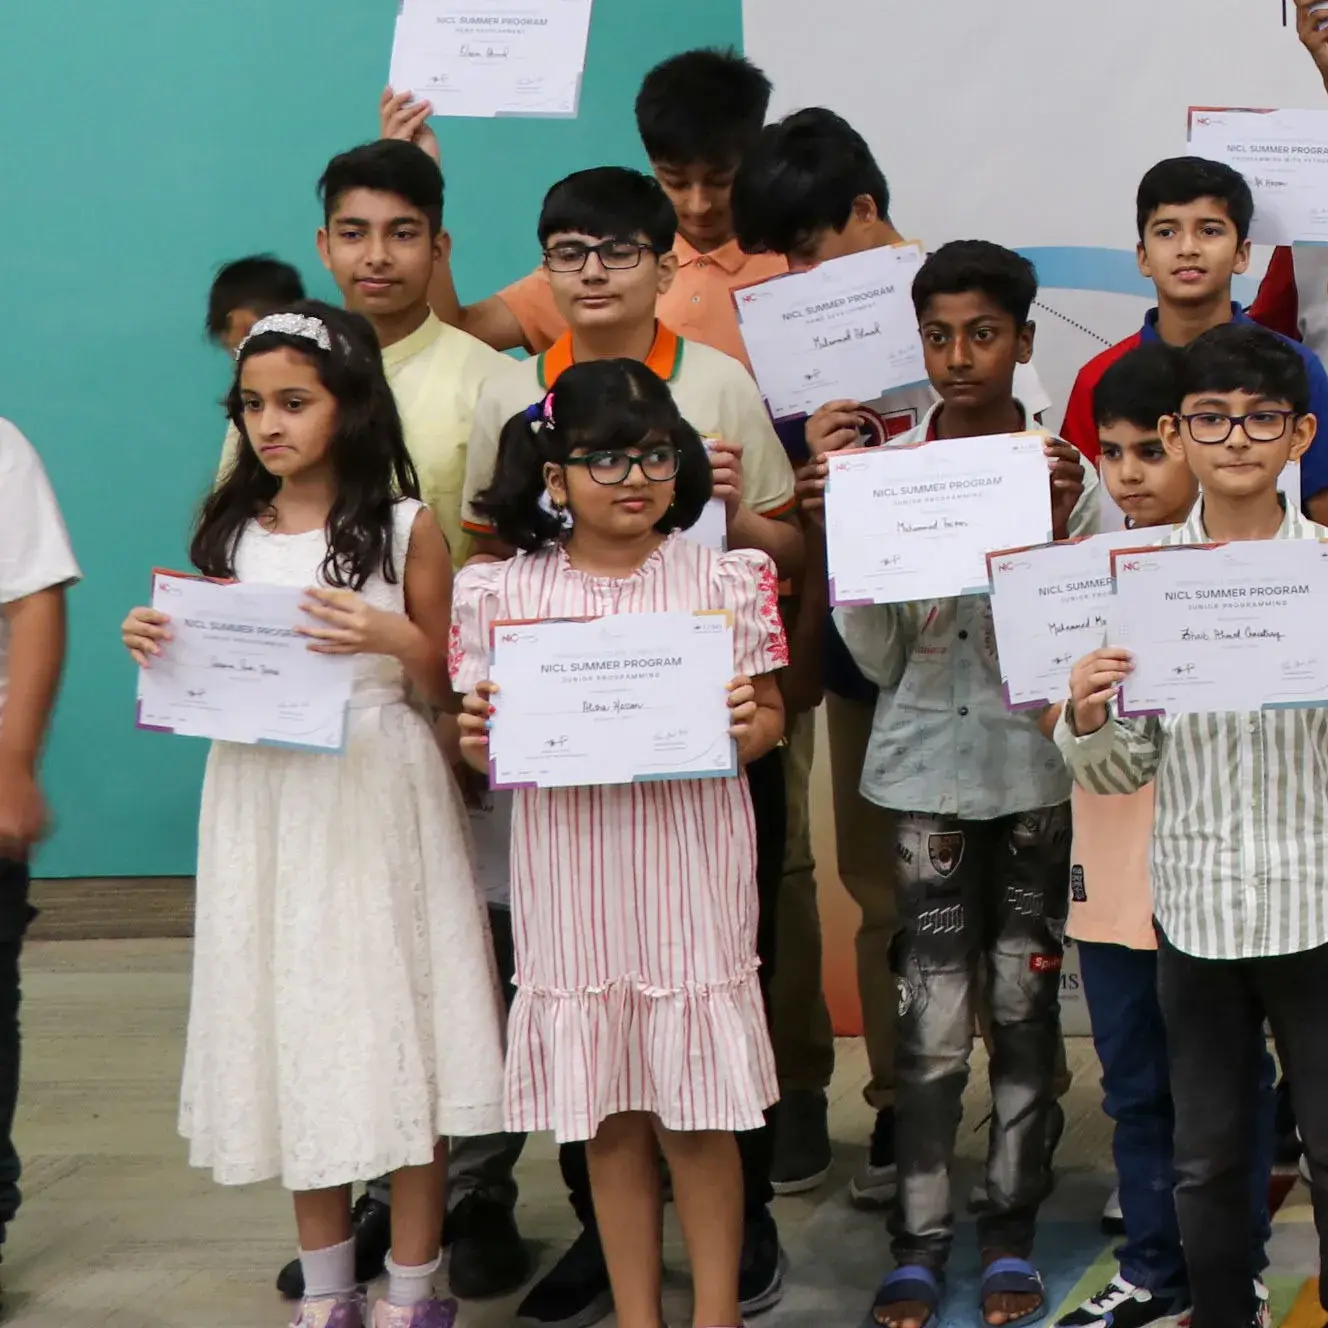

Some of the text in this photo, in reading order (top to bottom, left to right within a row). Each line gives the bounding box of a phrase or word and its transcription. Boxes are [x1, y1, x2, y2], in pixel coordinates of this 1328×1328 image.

[1250, 145, 1289, 153] SUMMER
[782, 310, 803, 321] NICL
[805, 299, 846, 315] SUMMER
[848, 286, 894, 303] PROGRAM
[873, 477, 1002, 498] NICL SUMMER PROGRAM
[1123, 561, 1139, 571] NIC
[1039, 585, 1063, 596] NICL
[1165, 585, 1309, 600] NICL SUMMER PROGRAM
[502, 634, 519, 643] NIC
[541, 657, 682, 673] NICL SUMMER PROGRAM
